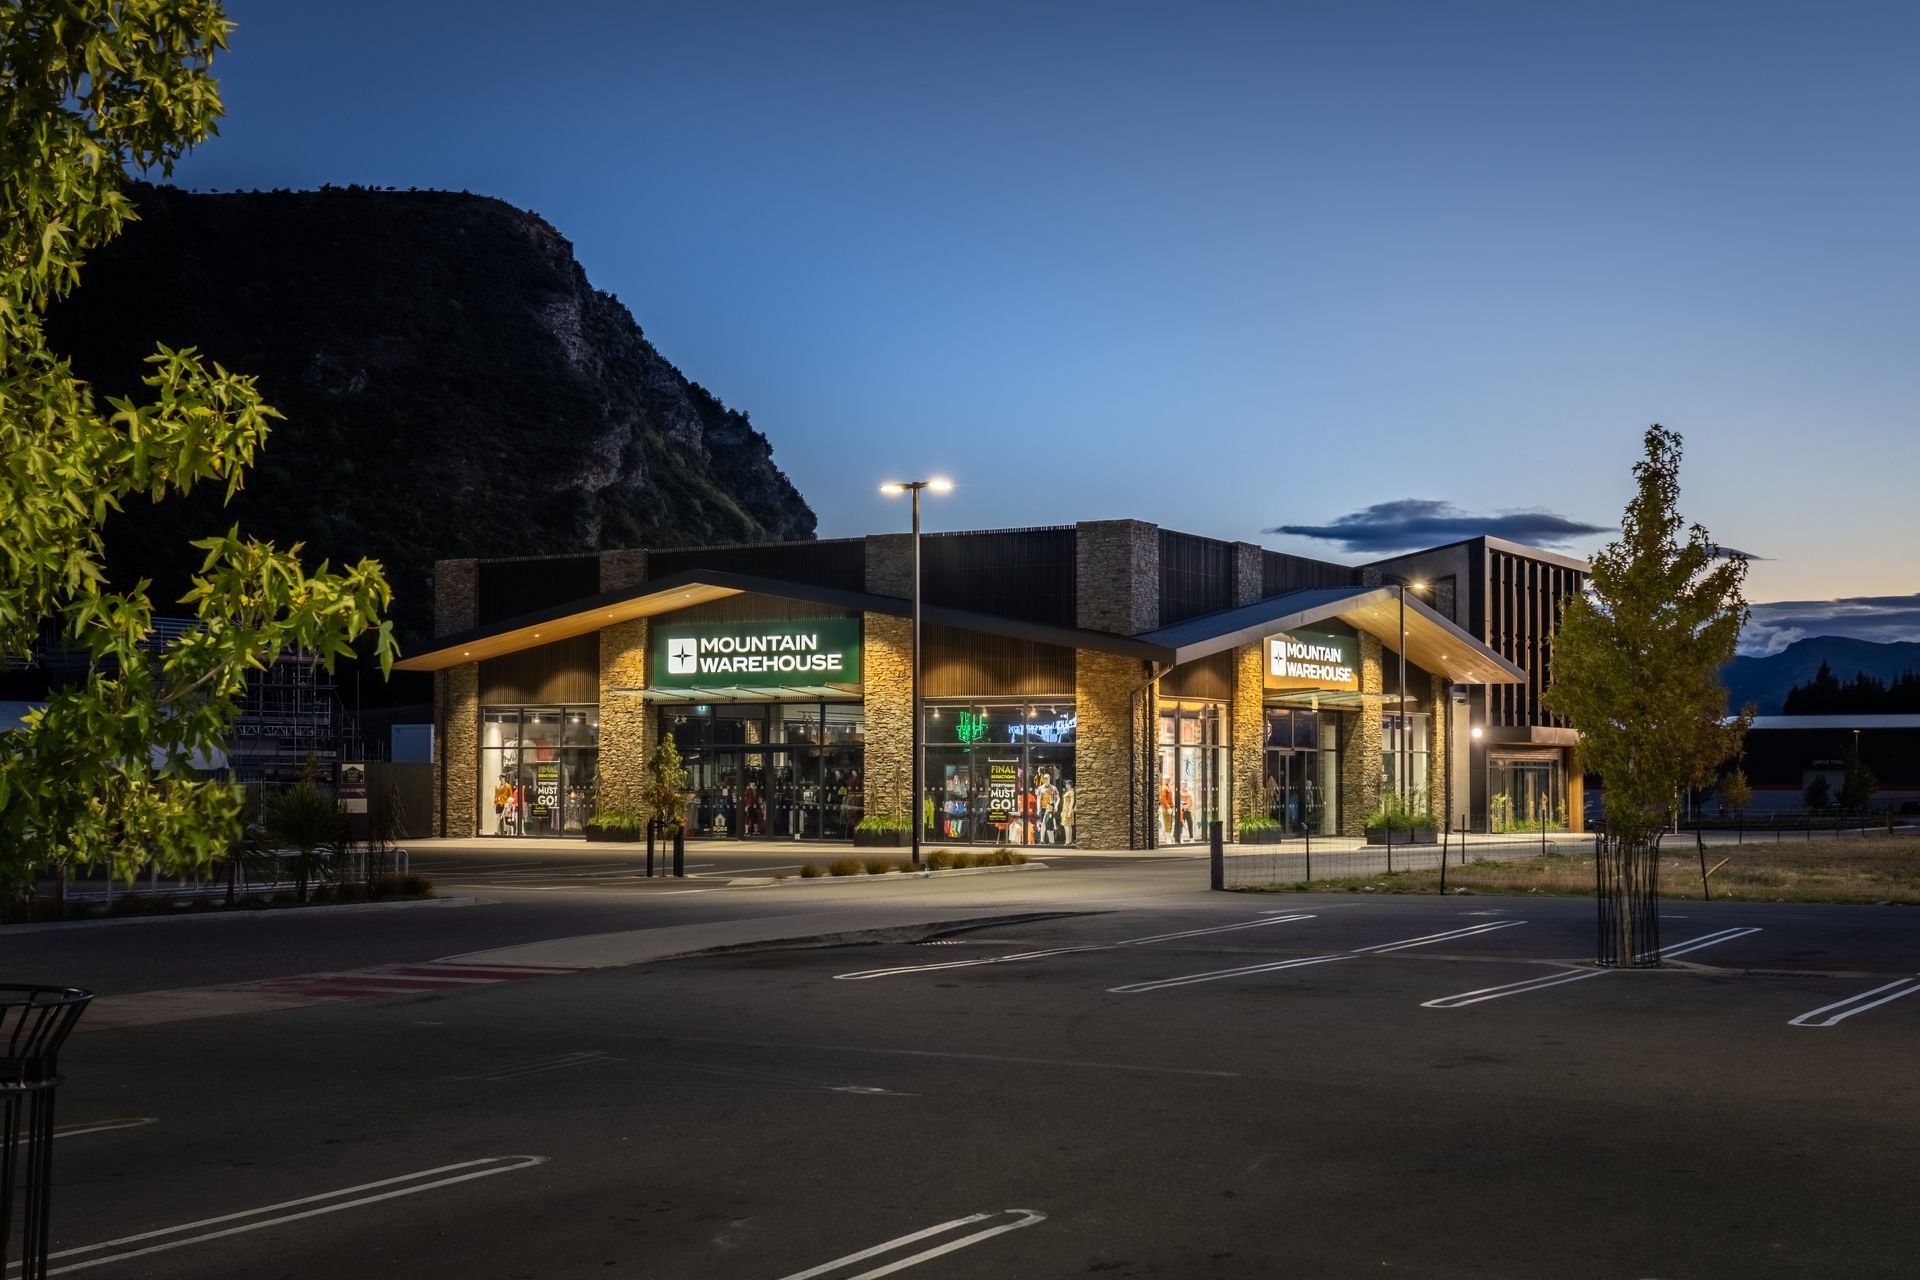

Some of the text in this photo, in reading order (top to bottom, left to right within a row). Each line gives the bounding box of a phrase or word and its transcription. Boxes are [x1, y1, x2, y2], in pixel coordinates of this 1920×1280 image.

[700, 634, 817, 653] MOUNTAIN
[1286, 642, 1342, 663] MOUNTAIN
[699, 653, 843, 673] WAREHOUSE
[1286, 661, 1353, 682] WAREHOUSE
[991, 765, 1016, 773] FINAL
[538, 786, 558, 795] MUST
[991, 789, 1016, 798] MUST
[538, 795, 558, 806] GO!
[990, 798, 1016, 812] GO!
